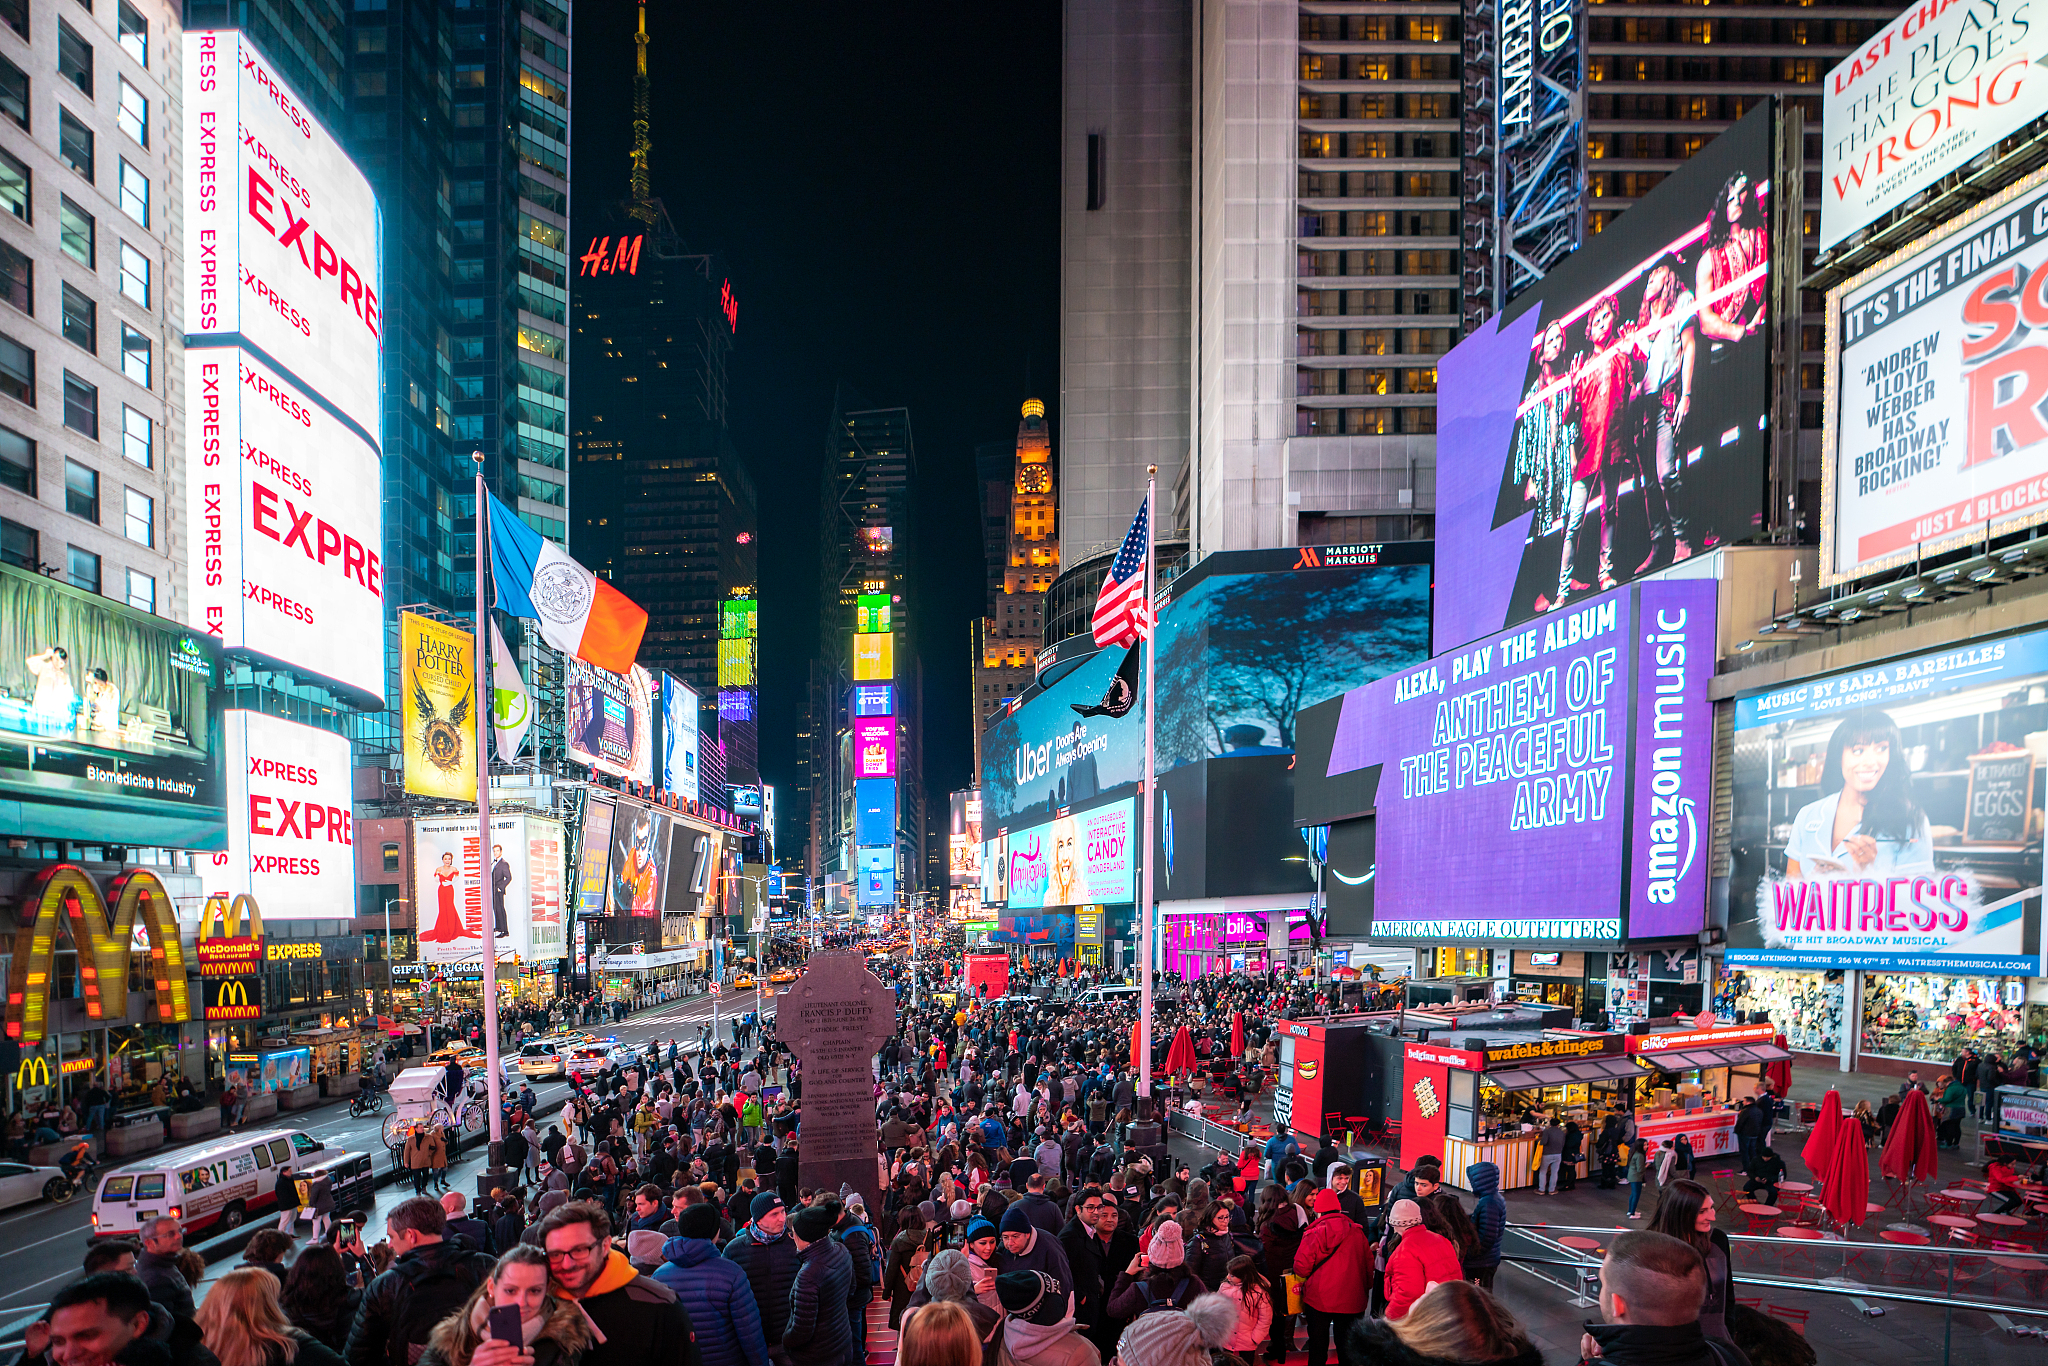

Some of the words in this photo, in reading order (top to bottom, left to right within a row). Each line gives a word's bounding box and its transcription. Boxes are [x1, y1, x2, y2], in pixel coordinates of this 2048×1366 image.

[200, 30, 216, 92] RESS
[1835, 29, 1895, 96] LAST
[1846, 71, 1899, 123] THE
[1909, 0, 2001, 82] PLAY
[1833, 96, 1903, 162] THAT
[1910, 2, 2030, 109] GOES
[1831, 59, 2028, 202] WRONG
[200, 112, 216, 212] EXPRESS
[1866, 194, 1880, 207] 149
[1883, 175, 1908, 196] WEST
[1912, 157, 1936, 176] 45TH
[1939, 129, 1977, 160] STREET
[249, 165, 383, 350] EXPRE
[580, 235, 643, 277] H&M
[201, 229, 217, 330] EXPRESS
[1845, 293, 1890, 343] IT'S
[1894, 261, 1942, 314] THE
[1947, 215, 2026, 286] FINAL
[1861, 331, 1940, 387] "ANDREW
[1875, 360, 1928, 404] LLOYD
[203, 364, 220, 466] EXPRESS
[1866, 380, 1935, 428] WEBBER
[1882, 411, 1917, 443] HAS
[1854, 418, 1951, 478] BROADWAY
[1859, 440, 1950, 497] ROCKING!"
[205, 484, 222, 586] EXPRESS
[1910, 508, 1955, 541] JUST
[1960, 503, 1972, 524] 4
[253, 480, 385, 607] EXPRE
[1326, 545, 1383, 555] MARRIOTT
[1326, 555, 1376, 565] MARQUIS
[863, 581, 885, 590] 2018
[416, 648, 467, 679] POTTER
[419, 632, 463, 662] HARRY
[1394, 665, 1446, 704] ALEXA,
[1452, 645, 1493, 685] PLAY
[1499, 629, 1537, 668] THE
[1542, 599, 1616, 654] ALBUM
[422, 671, 443, 683] CURSED
[445, 678, 462, 688] CHILD
[1647, 607, 1687, 741] music
[1757, 688, 1808, 712] MUSIC
[1813, 681, 1834, 699] BY
[1839, 671, 1889, 694] SARA
[1895, 643, 2006, 683] BAREILLES
[1432, 666, 1557, 746] ANTHEM
[1566, 647, 1616, 712] OF
[1810, 696, 1843, 712] "LOVE
[1884, 676, 1935, 697] "BRAVE"
[1055, 748, 1076, 769] Always
[1077, 734, 1108, 760] Opening
[1056, 732, 1074, 749] Doors
[1075, 725, 1087, 740] Are
[1400, 745, 1449, 800] THE
[1455, 709, 1614, 790] PEACEFUL
[87, 765, 154, 790] Biomedicine
[157, 777, 196, 797] Industry
[1016, 740, 1053, 785] Uber
[621, 776, 666, 805] 1540
[668, 792, 741, 829] BROADWAY
[1510, 765, 1614, 831] ARMY
[1973, 790, 2024, 817] EGGS
[1087, 821, 1126, 841] INTERACTIVE
[1647, 747, 1690, 904] amazon
[463, 837, 480, 878] PRETTY
[585, 848, 608, 863] COME
[1087, 836, 1126, 862] CANDY
[1087, 861, 1125, 874] WONDERLAND
[530, 840, 546, 922] WOMAN
[545, 840, 561, 924] PRETTY
[581, 877, 605, 893] AWAY
[464, 886, 482, 932] WOMAN
[1772, 874, 1969, 933] WAITRESS
[199, 943, 260, 954] McDonald's
[532, 927, 540, 944] THE
[542, 926, 561, 943] MUSICAL
[1372, 921, 1447, 938] AMERICAN
[1448, 921, 1498, 938] EAGLE
[1500, 919, 1618, 939] OUTFITTERS
[1784, 936, 1803, 944] THE
[1805, 936, 1822, 945] HIT
[1826, 936, 1888, 945] BROADWAY
[1892, 937, 1948, 946] MUSICAL
[267, 943, 322, 960] EXPRESS
[1897, 958, 2032, 970] WAITRESSTHEMUSICAL.COM
[805, 1001, 839, 1009] LIEUTENANT
[1905, 977, 2026, 1006] GRAND
[268, 1025, 290, 1033] EXPRESS
[800, 1009, 834, 1018] FRANCIS
[845, 1006, 873, 1015] DUFFY
[1407, 1049, 1436, 1063] belgian
[1438, 1055, 1466, 1066] waffles
[1488, 1037, 1604, 1062] wafels&dinges
[1641, 1038, 1668, 1050] BING
[2004, 1108, 2047, 1124] WAITRESS
[210, 1160, 228, 1184] 17
